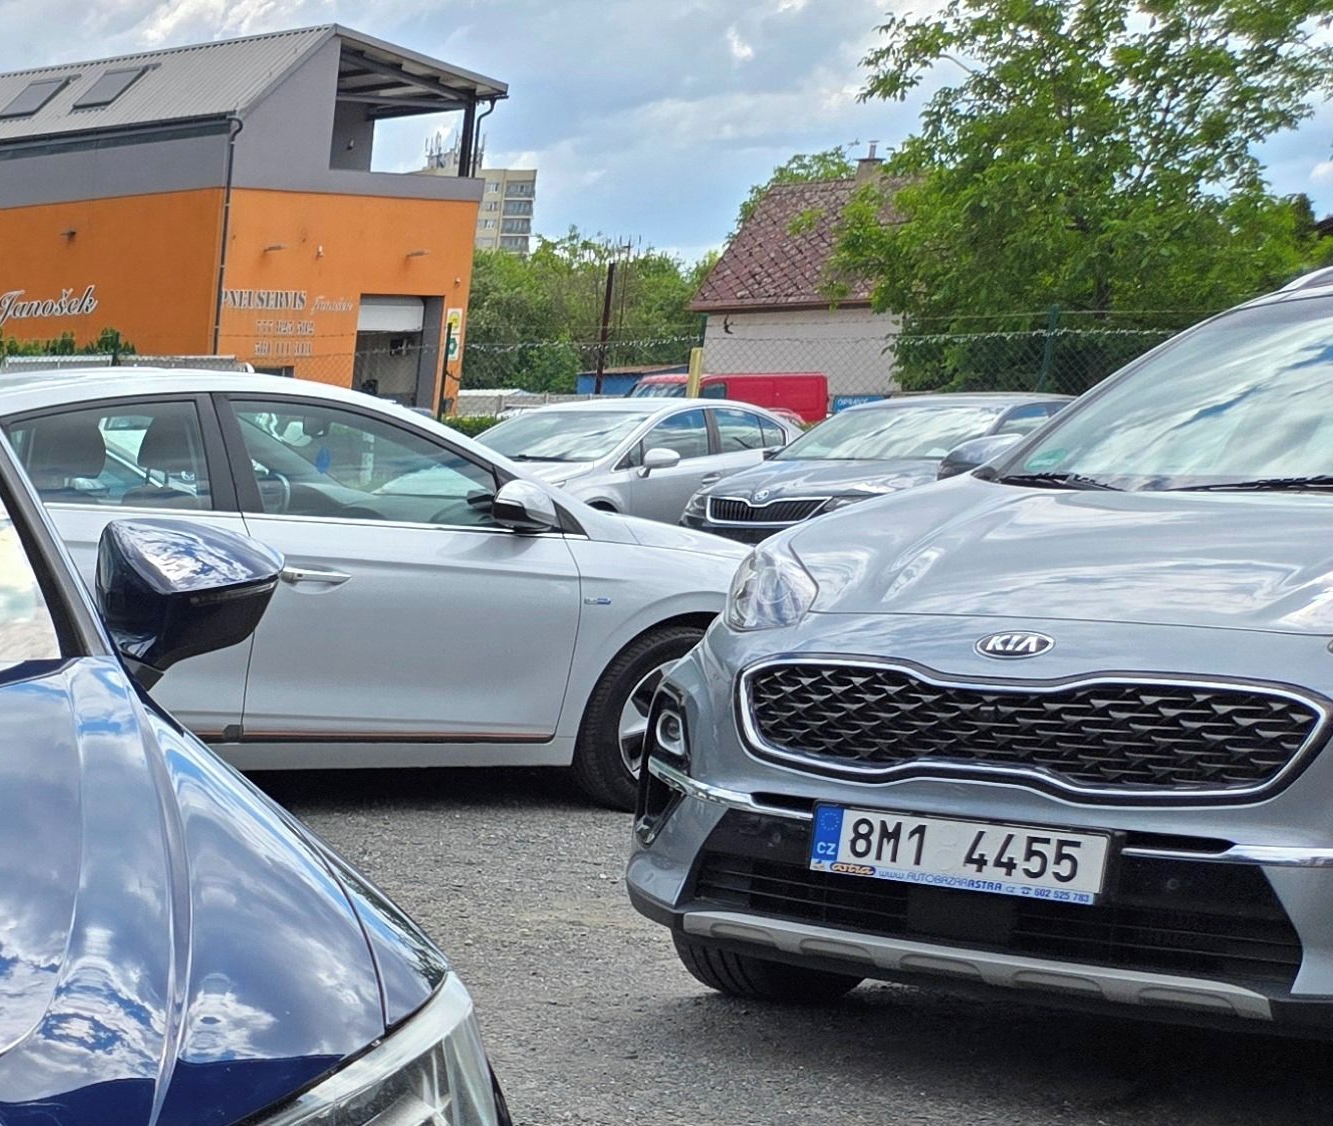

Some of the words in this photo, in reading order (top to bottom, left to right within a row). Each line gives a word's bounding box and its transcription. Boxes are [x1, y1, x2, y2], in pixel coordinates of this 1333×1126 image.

[985, 634, 1039, 653] KIA
[816, 841, 836, 855] CZ
[849, 817, 928, 867] 8M1
[963, 830, 1082, 883] 4455
[831, 862, 876, 876] astra
[1034, 888, 1051, 898] 602
[1053, 890, 1071, 900] 525
